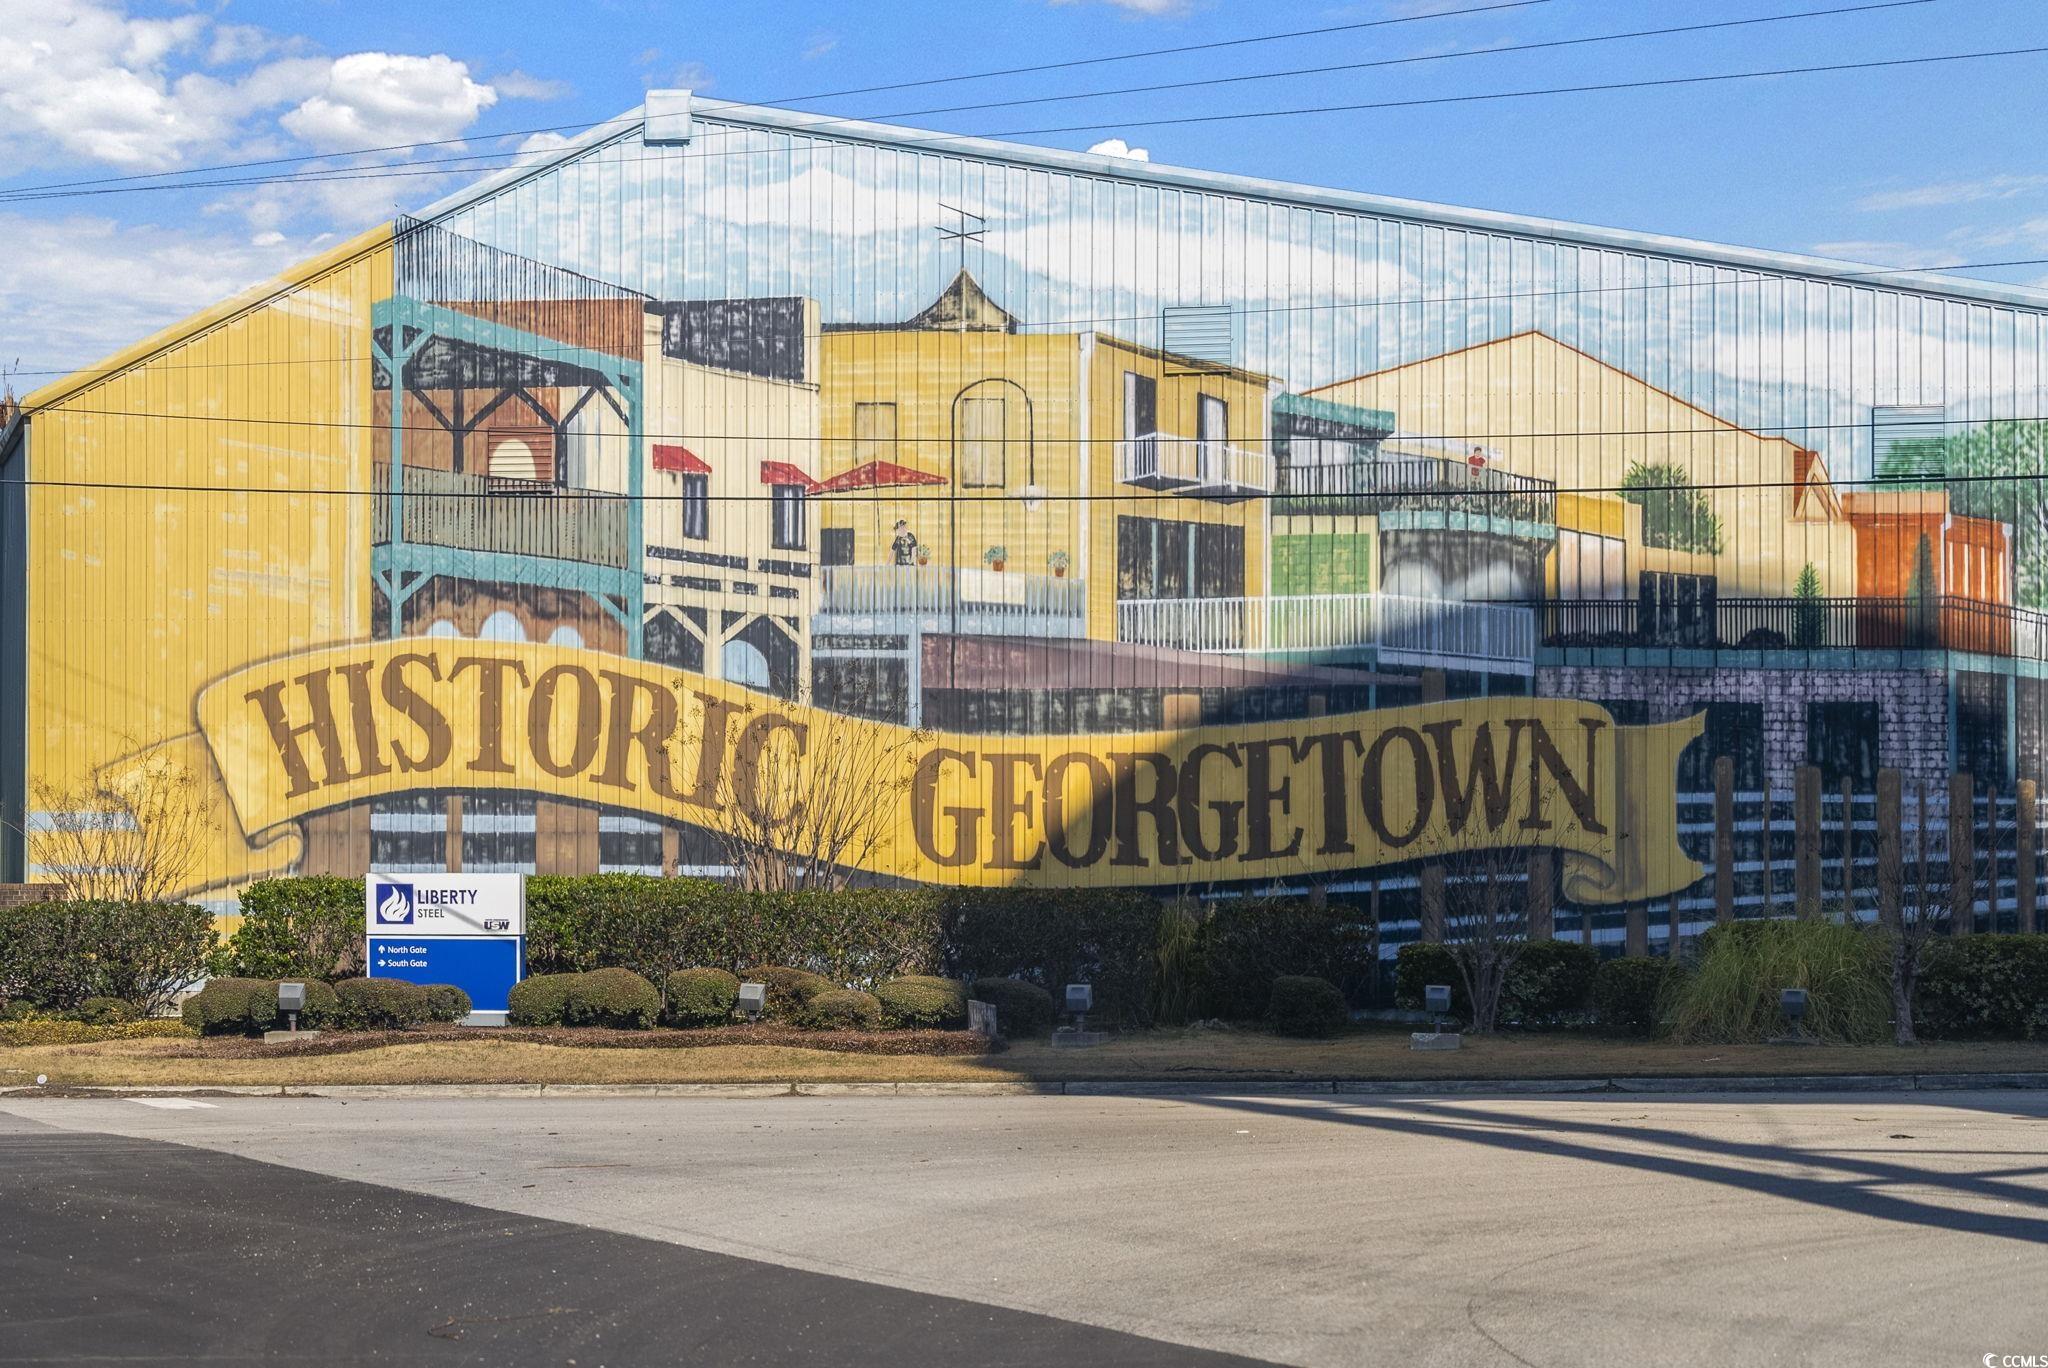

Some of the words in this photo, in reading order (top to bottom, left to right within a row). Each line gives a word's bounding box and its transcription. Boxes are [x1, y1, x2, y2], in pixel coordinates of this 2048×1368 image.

[245, 652, 808, 827] HISTORIC
[910, 717, 1609, 871] GEORGETOWN
[417, 889, 478, 905] LIBERTY
[417, 908, 445, 918] STEEL
[484, 921, 510, 930] USW
[387, 946, 408, 954] North
[409, 946, 427, 954] Gate
[387, 959, 408, 967] South
[410, 959, 427, 967] Gate
